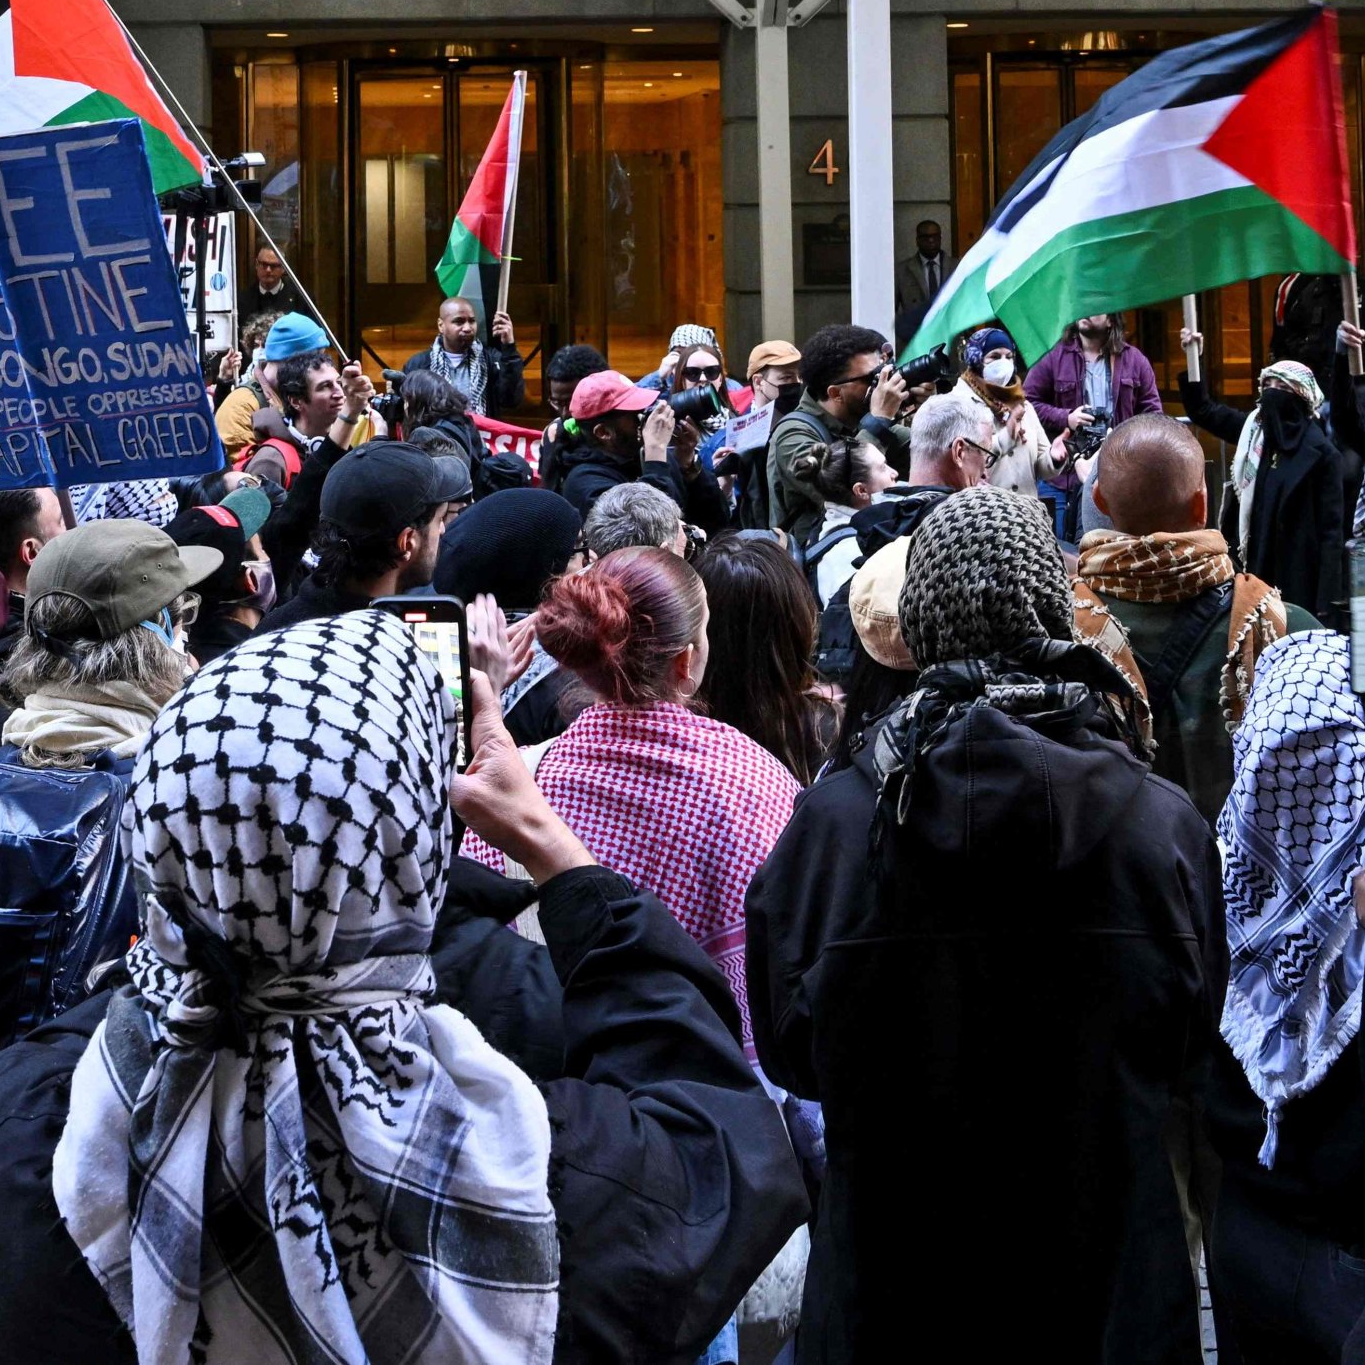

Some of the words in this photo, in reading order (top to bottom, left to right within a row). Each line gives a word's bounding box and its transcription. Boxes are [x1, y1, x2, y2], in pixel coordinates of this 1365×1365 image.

[809, 139, 839, 185] 4
[106, 339, 197, 381] SUDAN
[87, 382, 201, 415] OPPRESSED
[117, 412, 211, 461] GREED
